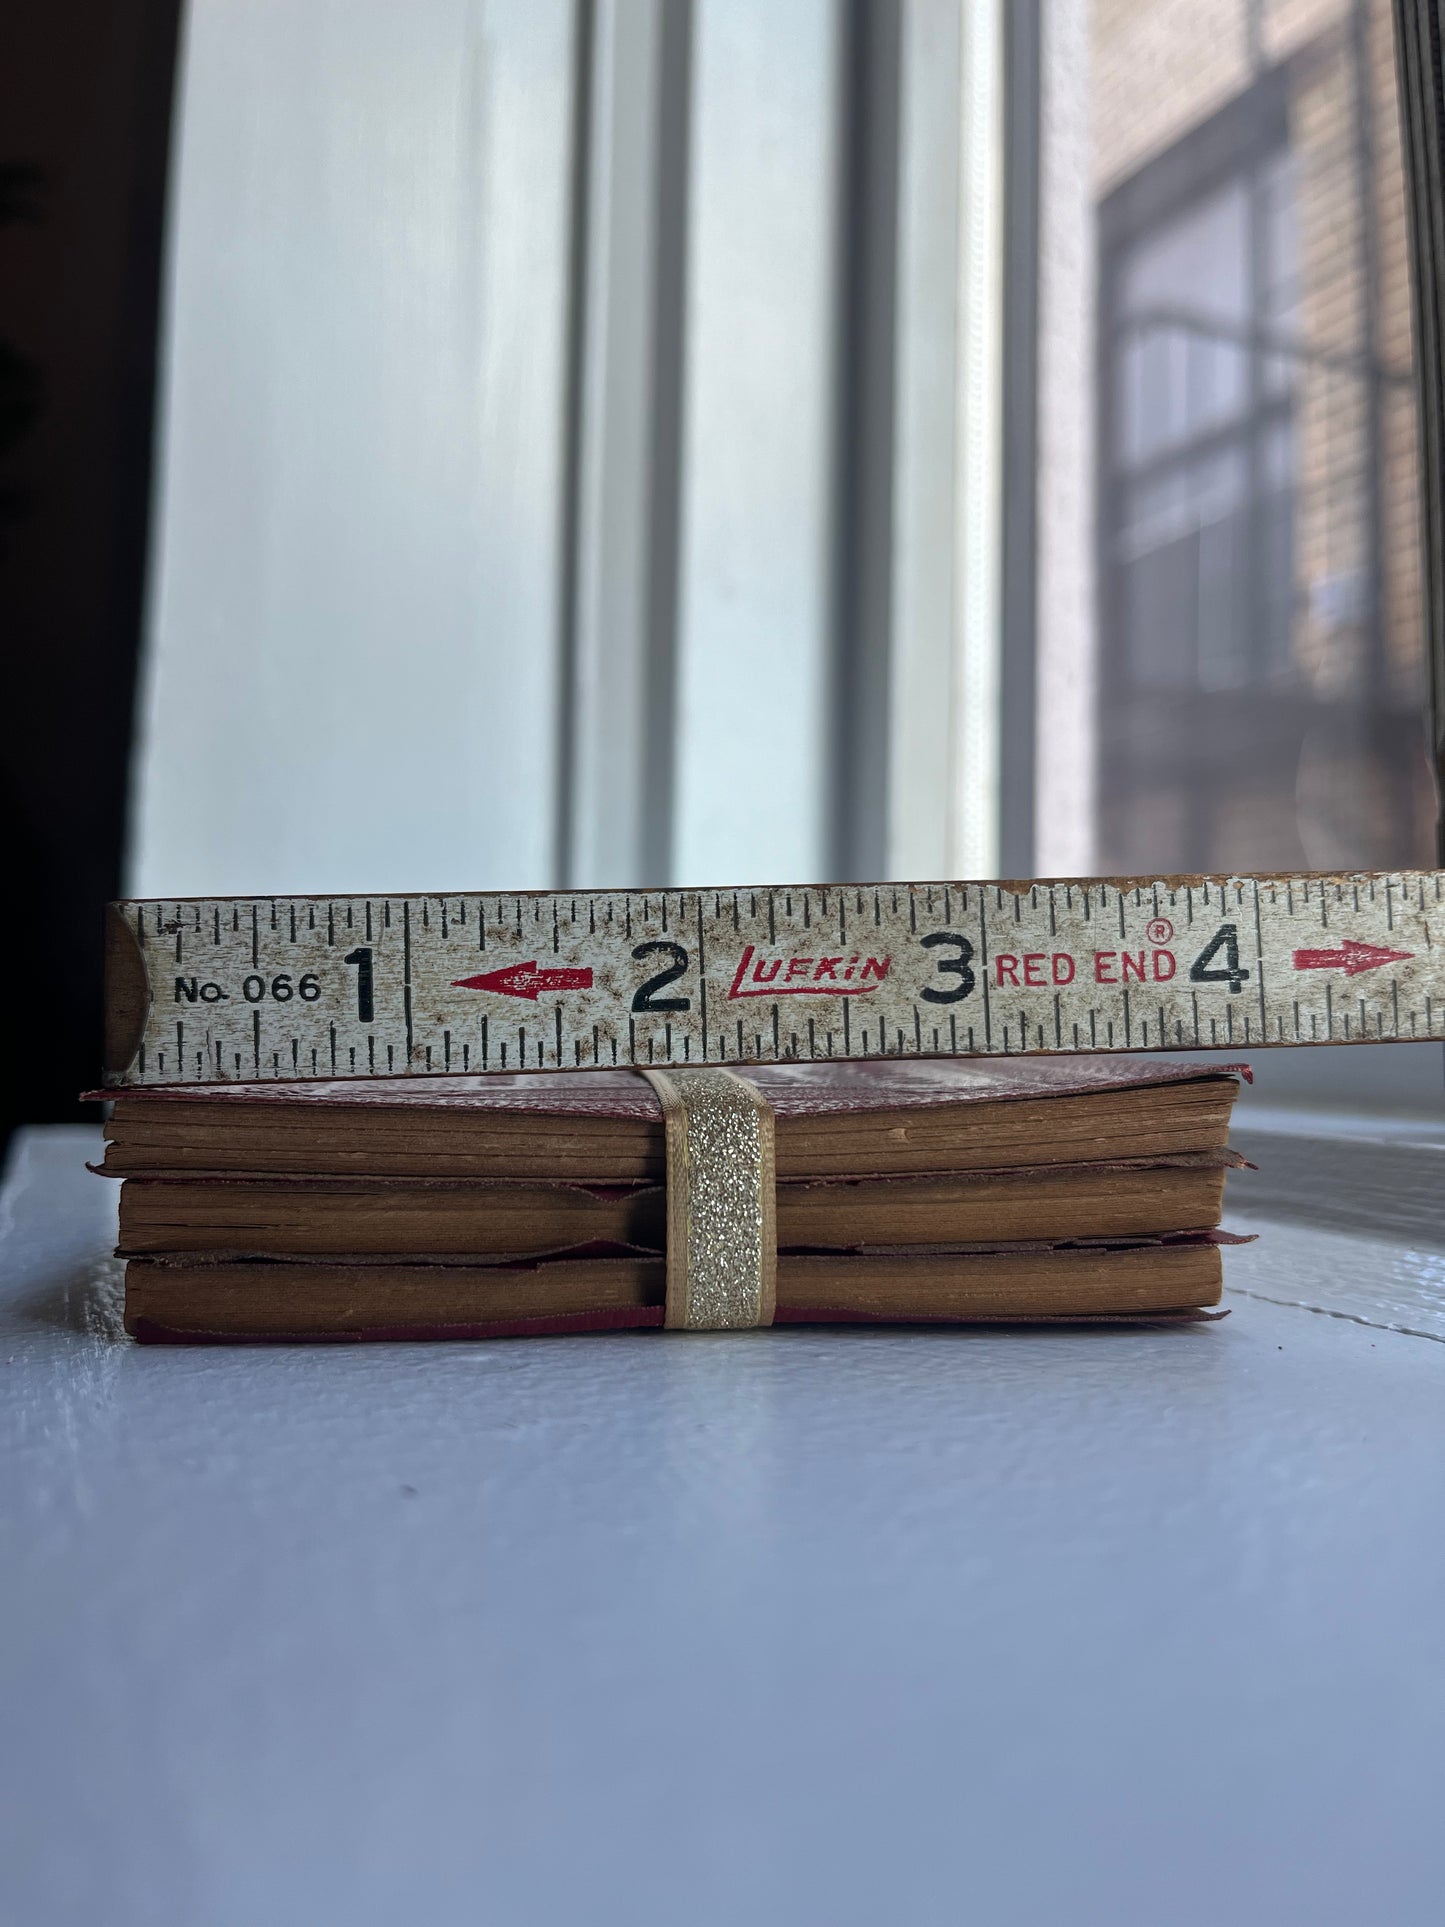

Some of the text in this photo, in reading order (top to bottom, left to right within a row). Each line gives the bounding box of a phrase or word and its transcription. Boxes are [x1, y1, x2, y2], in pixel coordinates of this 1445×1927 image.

[243, 973, 322, 1003] 066
[344, 947, 375, 1023] 1
[631, 941, 691, 1013] 2
[919, 931, 977, 1005] 3
[995, 949, 1177, 987] RED END
[1189, 923, 1250, 995] 4
